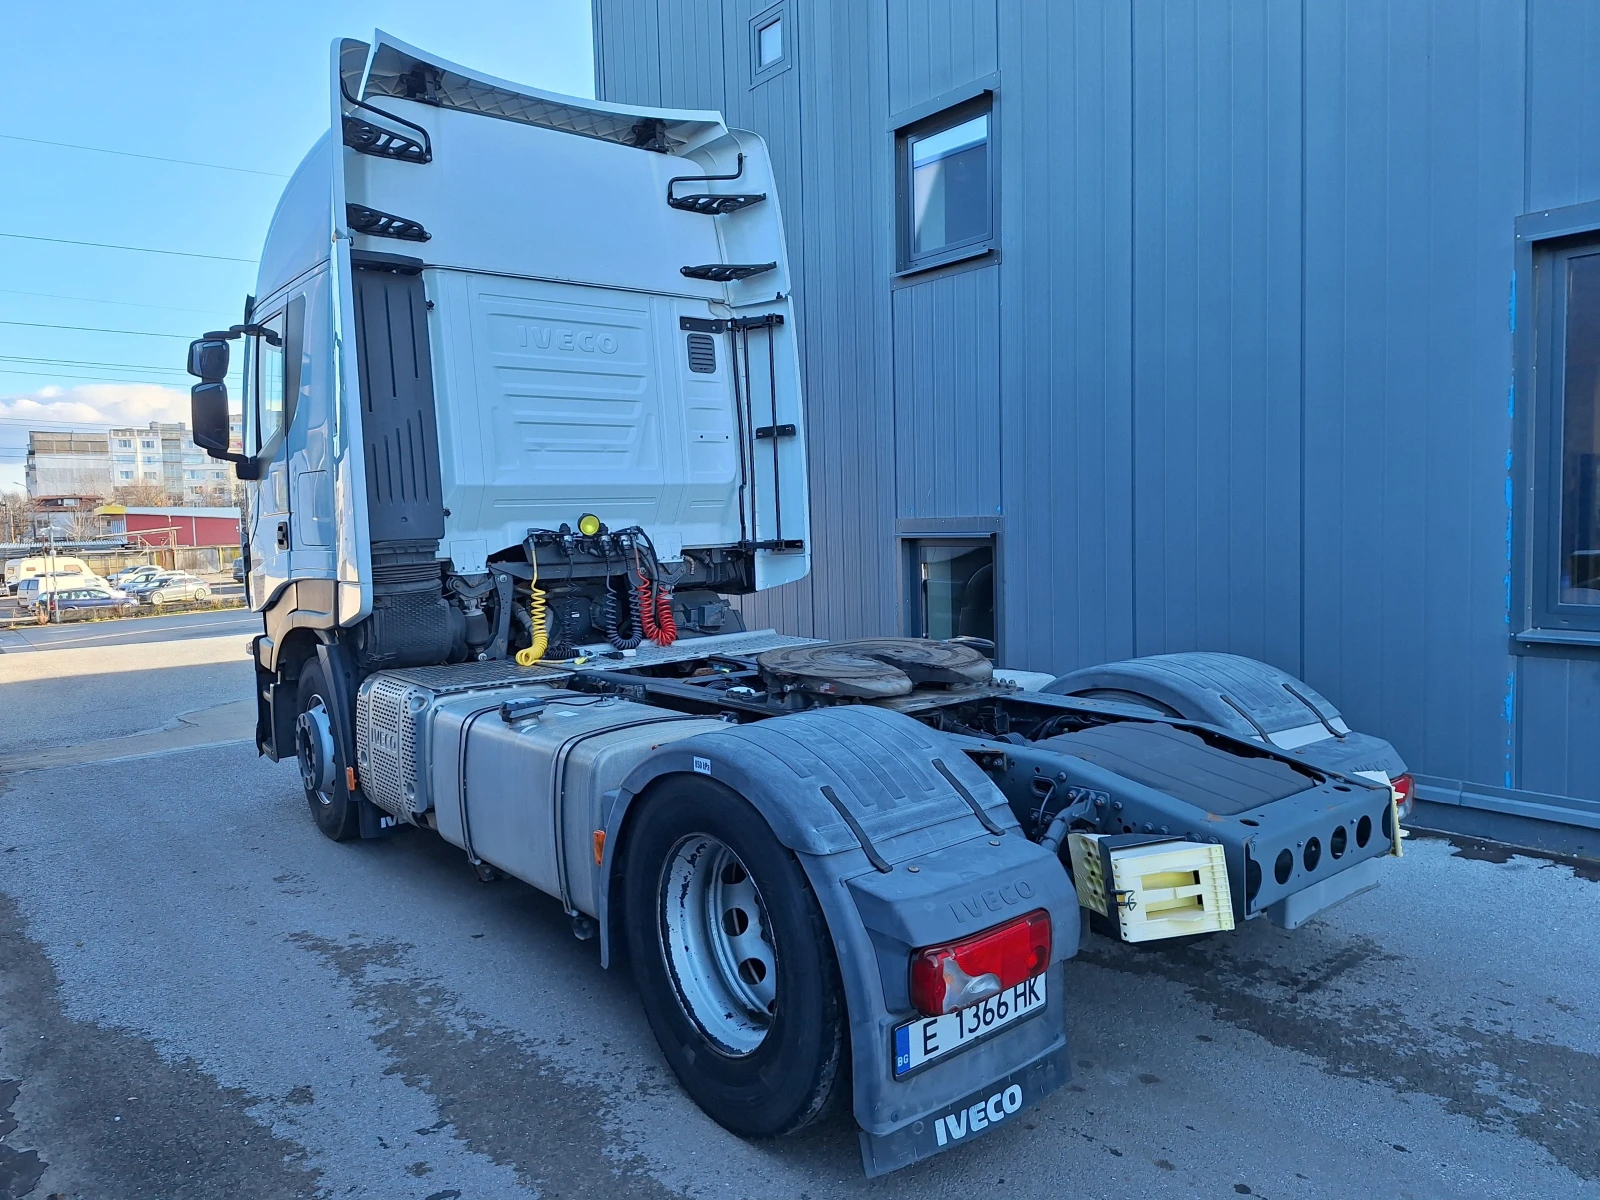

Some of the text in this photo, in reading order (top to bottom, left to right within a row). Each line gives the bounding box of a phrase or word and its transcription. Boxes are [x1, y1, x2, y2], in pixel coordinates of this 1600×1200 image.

[516, 325, 619, 355] IVECO
[370, 727, 397, 754] IVECO
[946, 879, 1036, 923] IVECO
[922, 977, 1041, 1057] E 1366 HK
[897, 1054, 909, 1067] BG
[934, 1083, 1023, 1147] IVECO
